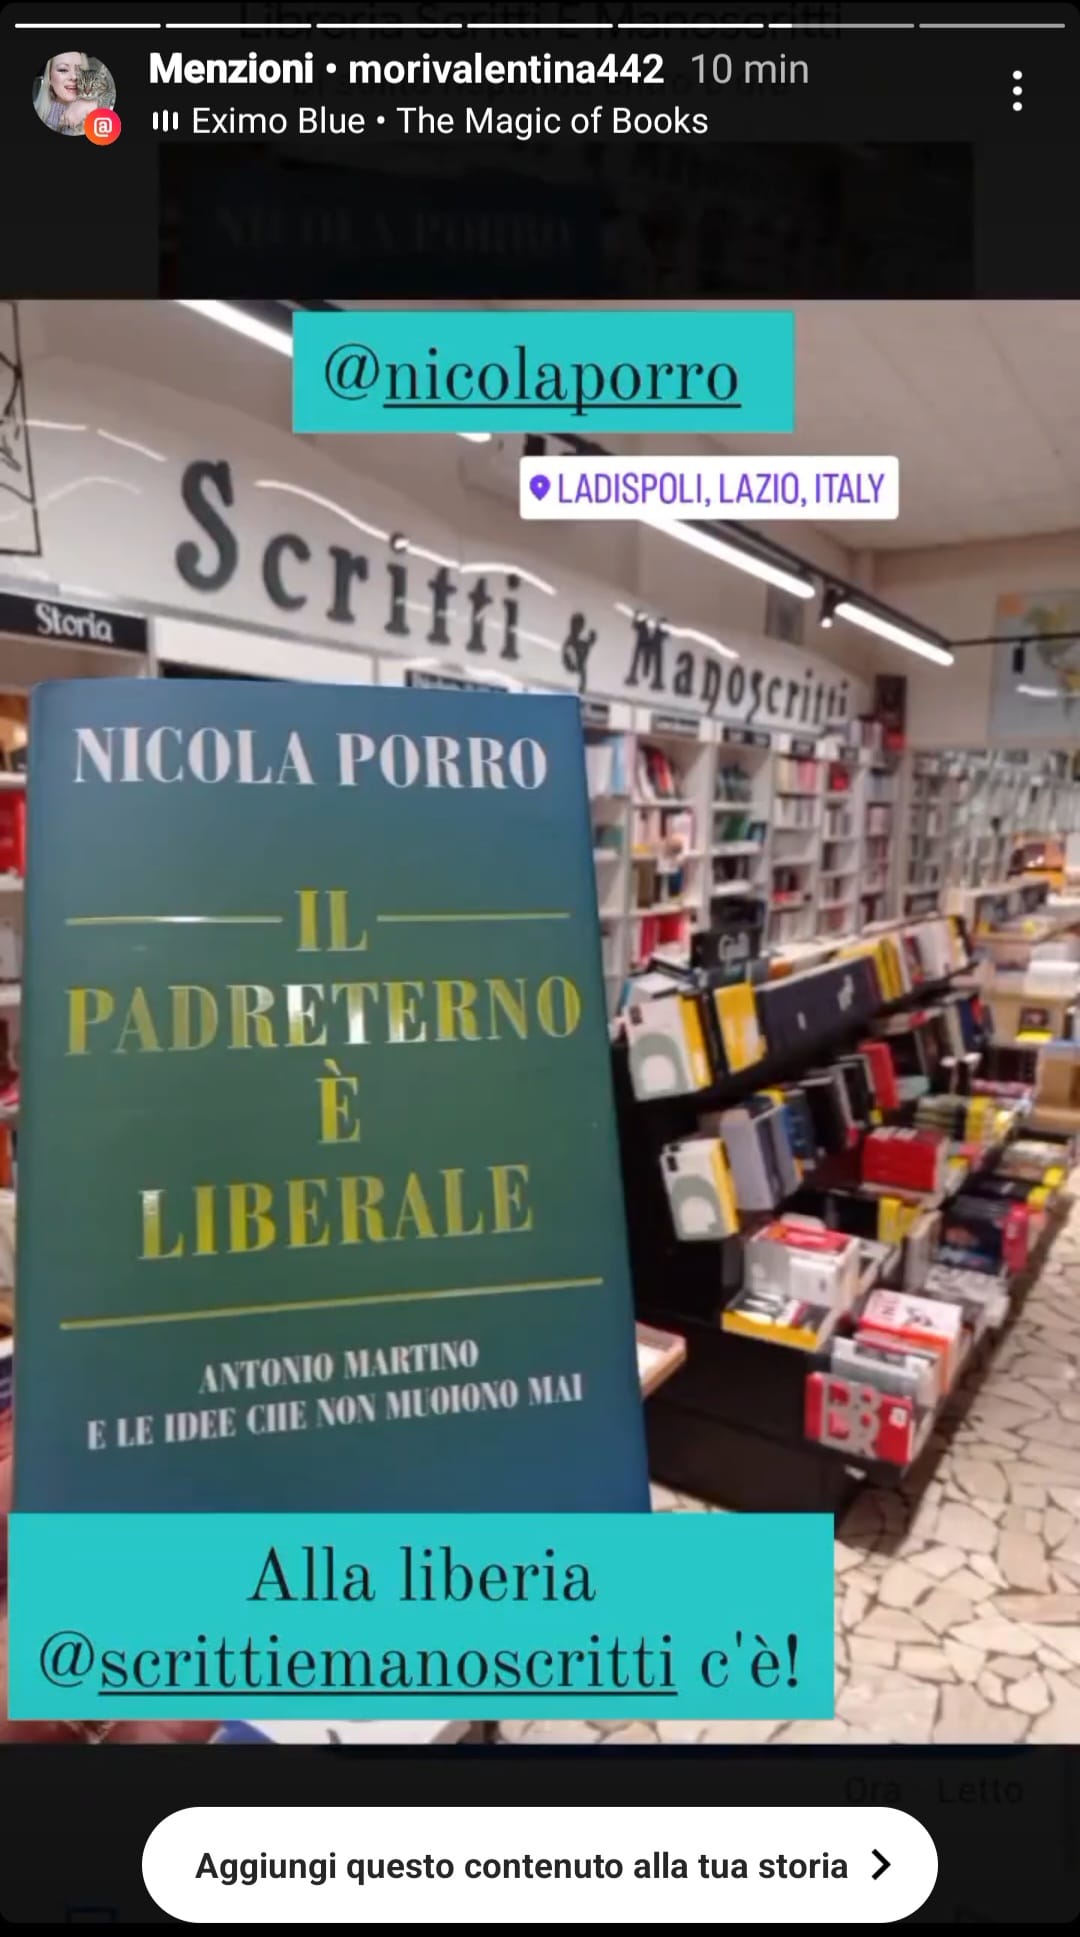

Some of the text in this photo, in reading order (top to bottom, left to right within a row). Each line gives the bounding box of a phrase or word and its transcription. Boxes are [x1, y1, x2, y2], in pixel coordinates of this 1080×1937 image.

[35, 602, 114, 643] Storia
[175, 459, 849, 723] Scritti & Manoscritti
[73, 726, 548, 790] NICOLA PORRO
[294, 889, 368, 953] IL
[64, 975, 583, 1056] PADRETERNO
[314, 1058, 362, 1145] È
[137, 1164, 534, 1260] LIBERALE
[198, 1338, 479, 1395] ANTONIO MARTINO
[86, 1373, 584, 1451] E LE IDEE CHE NON MUOIONO MAI
